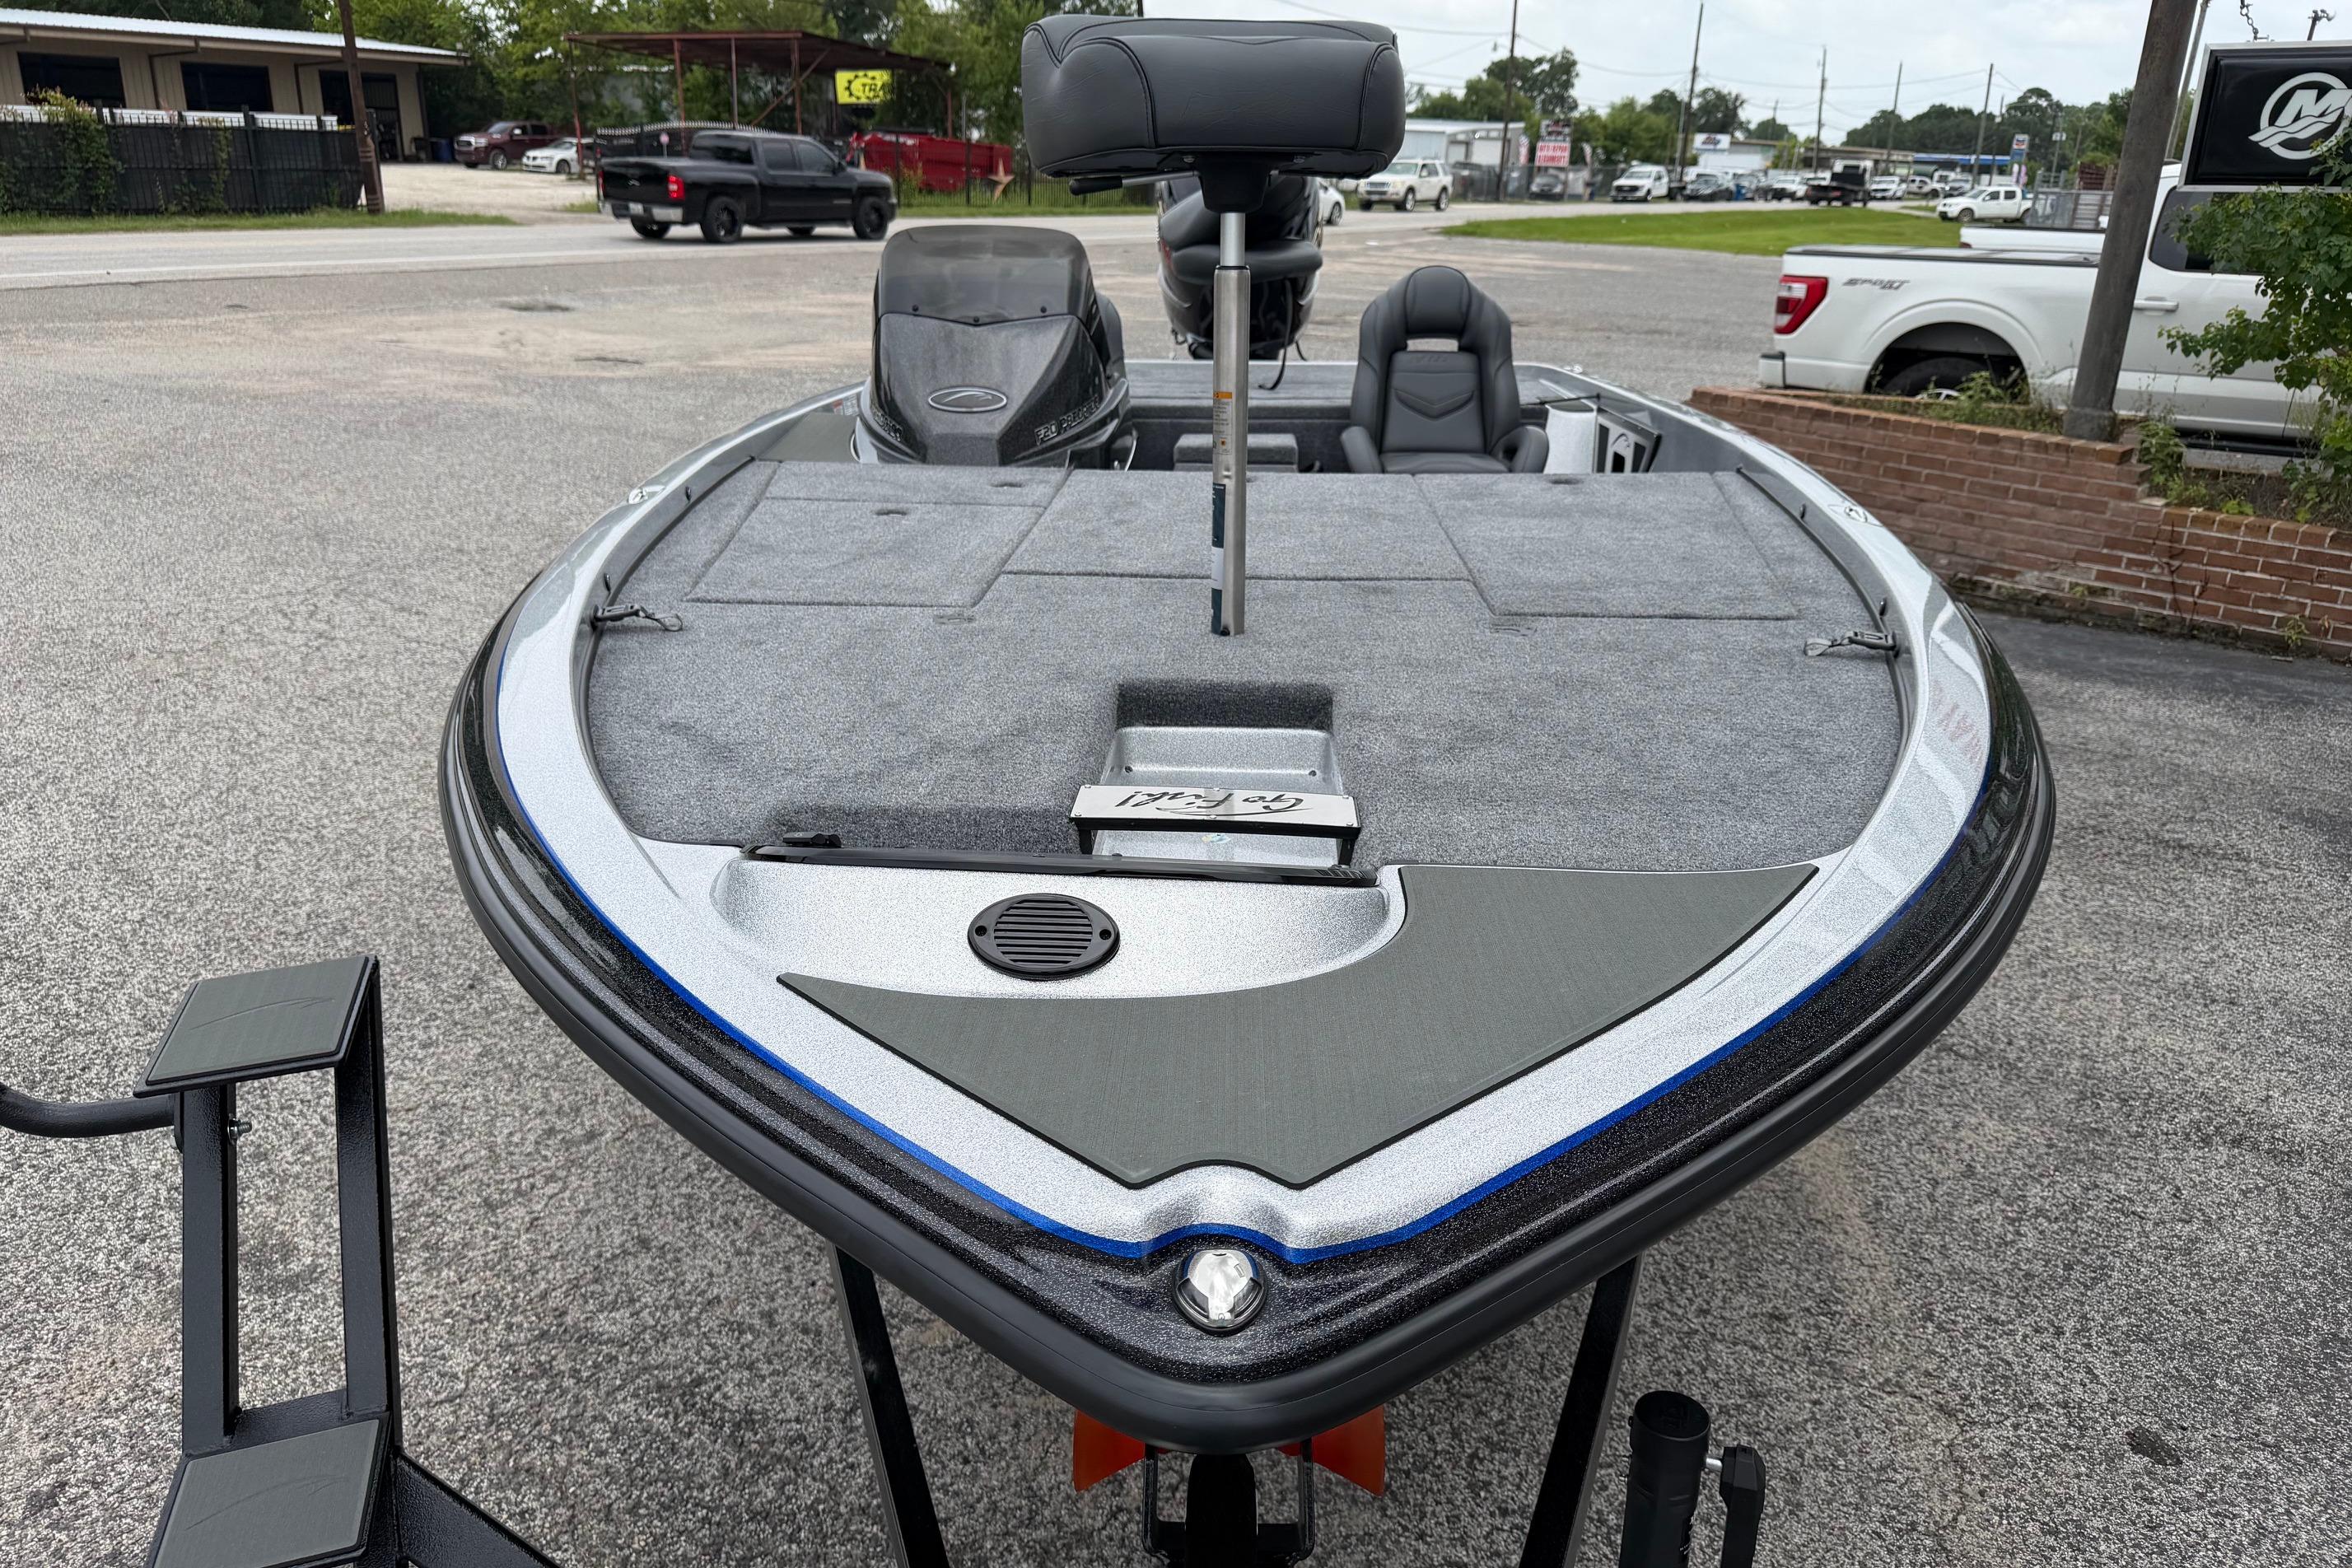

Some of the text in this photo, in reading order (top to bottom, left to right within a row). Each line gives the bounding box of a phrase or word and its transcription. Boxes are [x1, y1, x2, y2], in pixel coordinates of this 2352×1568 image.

[1034, 422, 1058, 446] F20
[1114, 791, 1304, 811] Go Fish!
